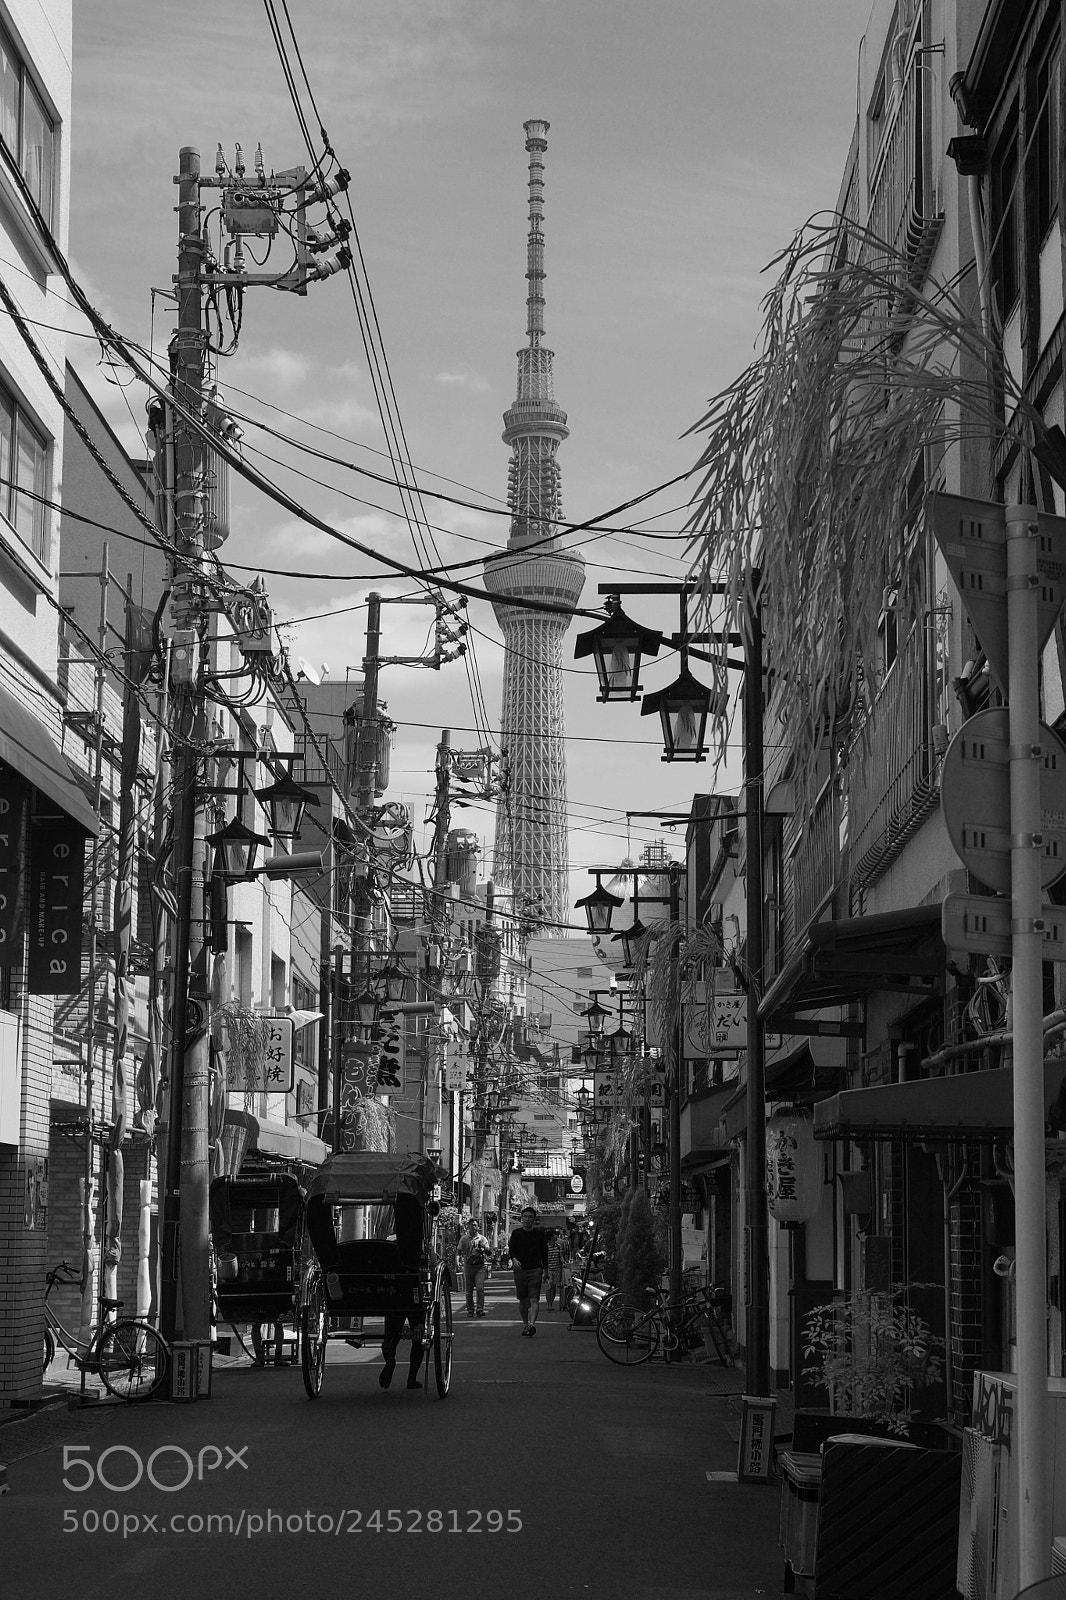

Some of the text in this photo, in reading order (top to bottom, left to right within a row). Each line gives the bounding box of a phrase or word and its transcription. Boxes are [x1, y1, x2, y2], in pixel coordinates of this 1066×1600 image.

[49, 843, 70, 976] erica
[266, 1028, 285, 1083] お好焼
